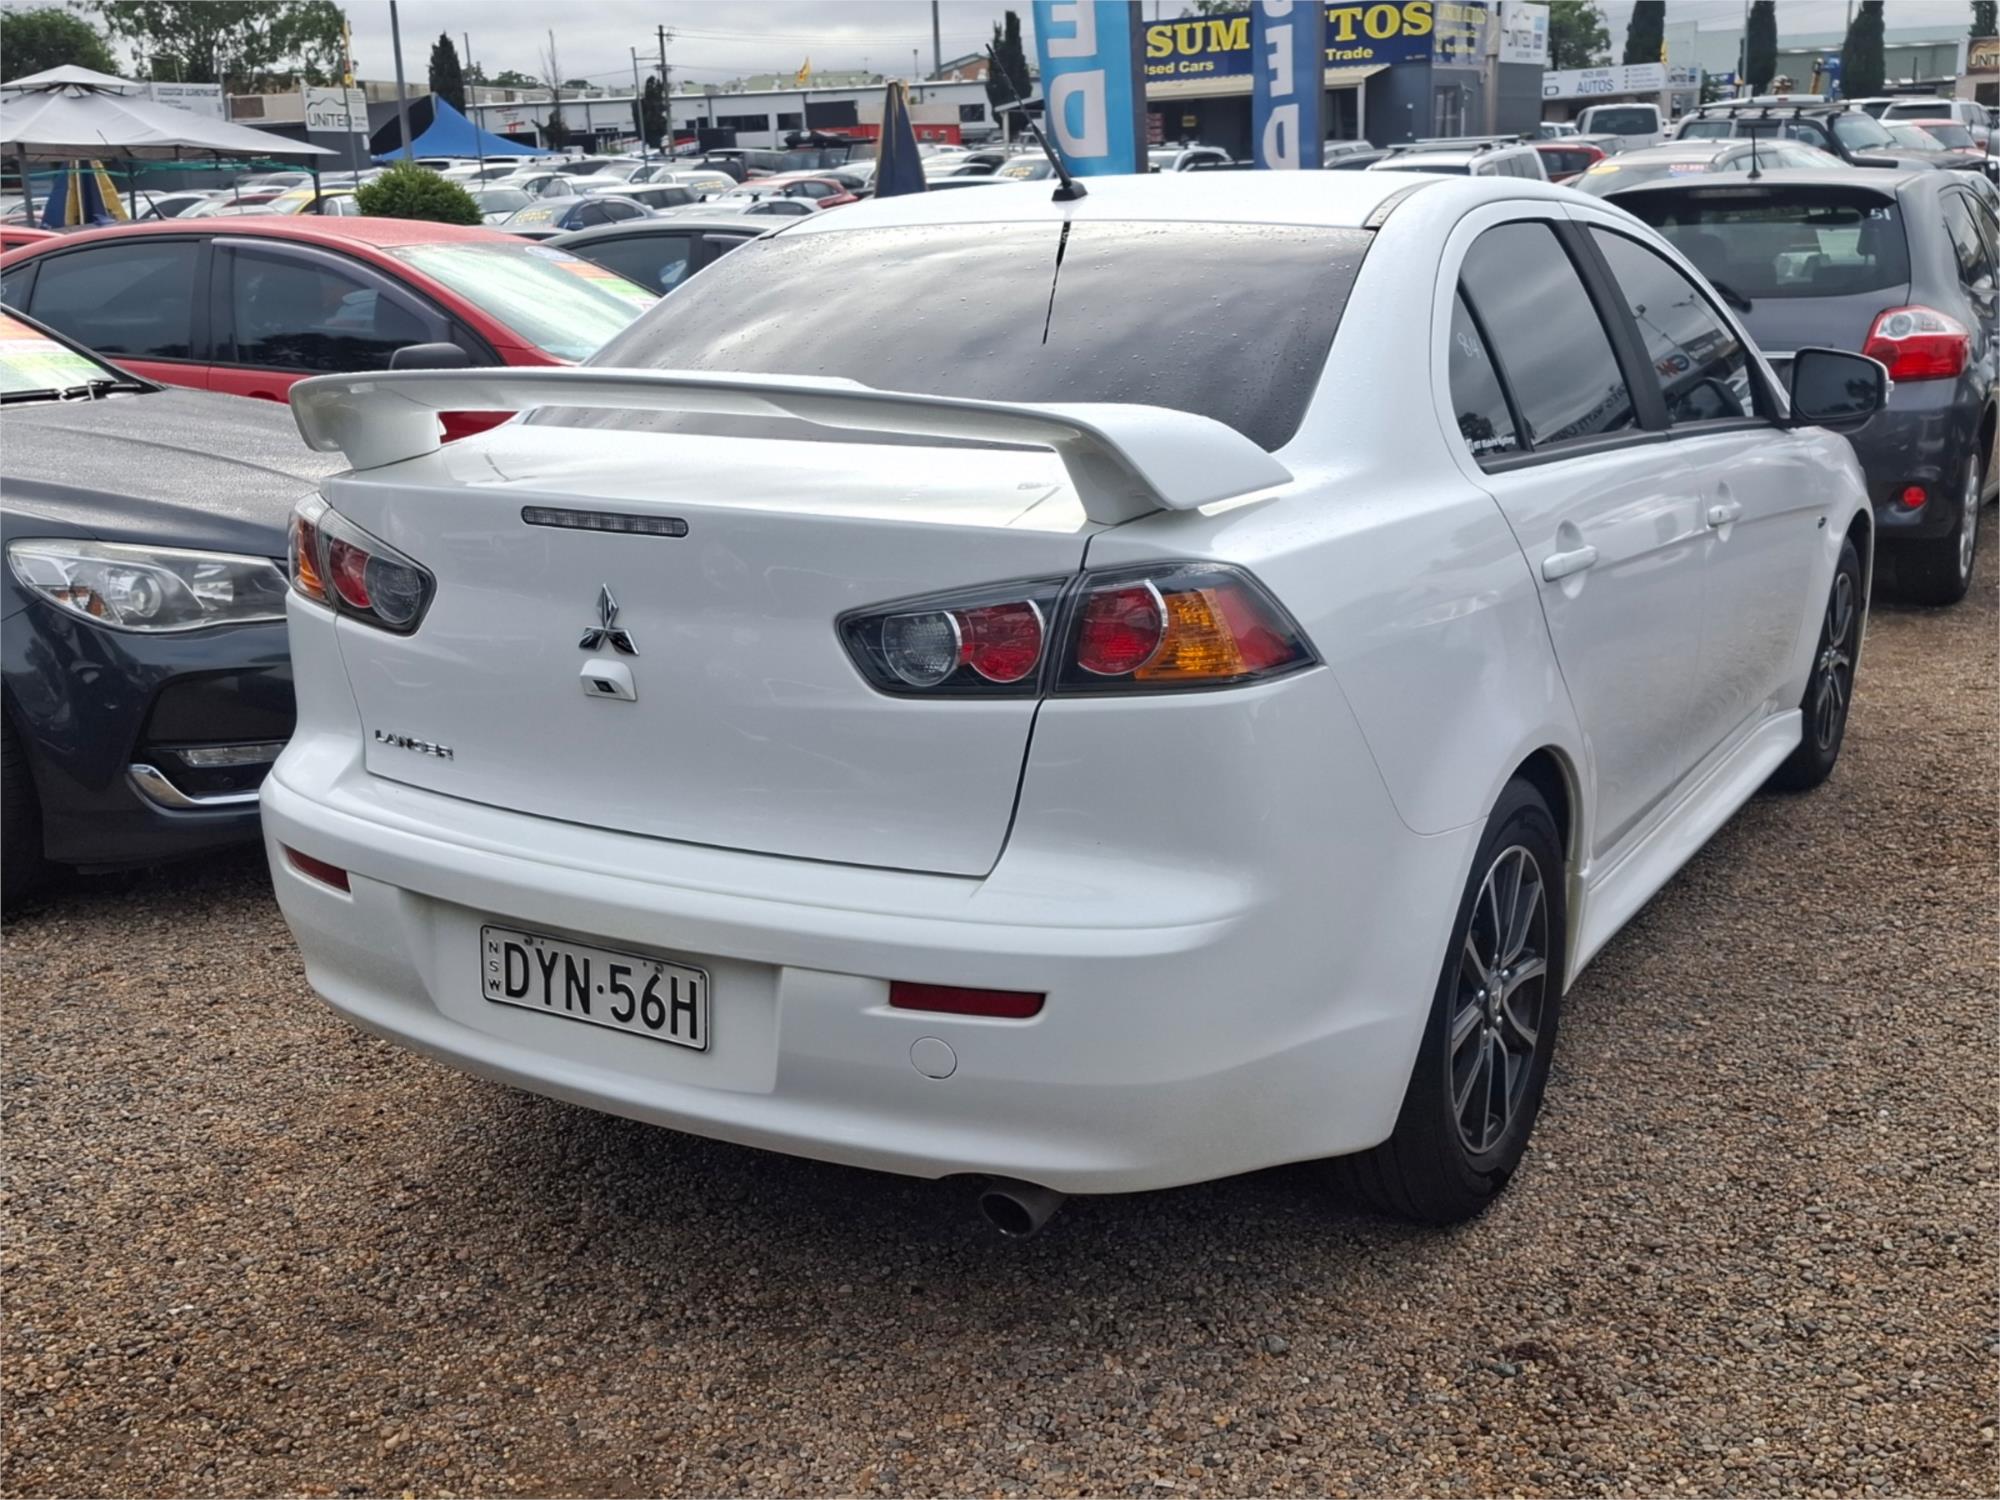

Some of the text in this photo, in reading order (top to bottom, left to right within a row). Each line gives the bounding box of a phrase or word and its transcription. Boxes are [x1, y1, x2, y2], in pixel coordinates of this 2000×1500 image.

[1146, 17, 1250, 58] SUM
[1324, 2, 1434, 42] TOS
[1179, 61, 1215, 73] Cars
[1324, 47, 1374, 61] Trade
[1576, 79, 1615, 94] AUTOS
[374, 729, 454, 761] LANCER
[488, 941, 501, 992] NSW
